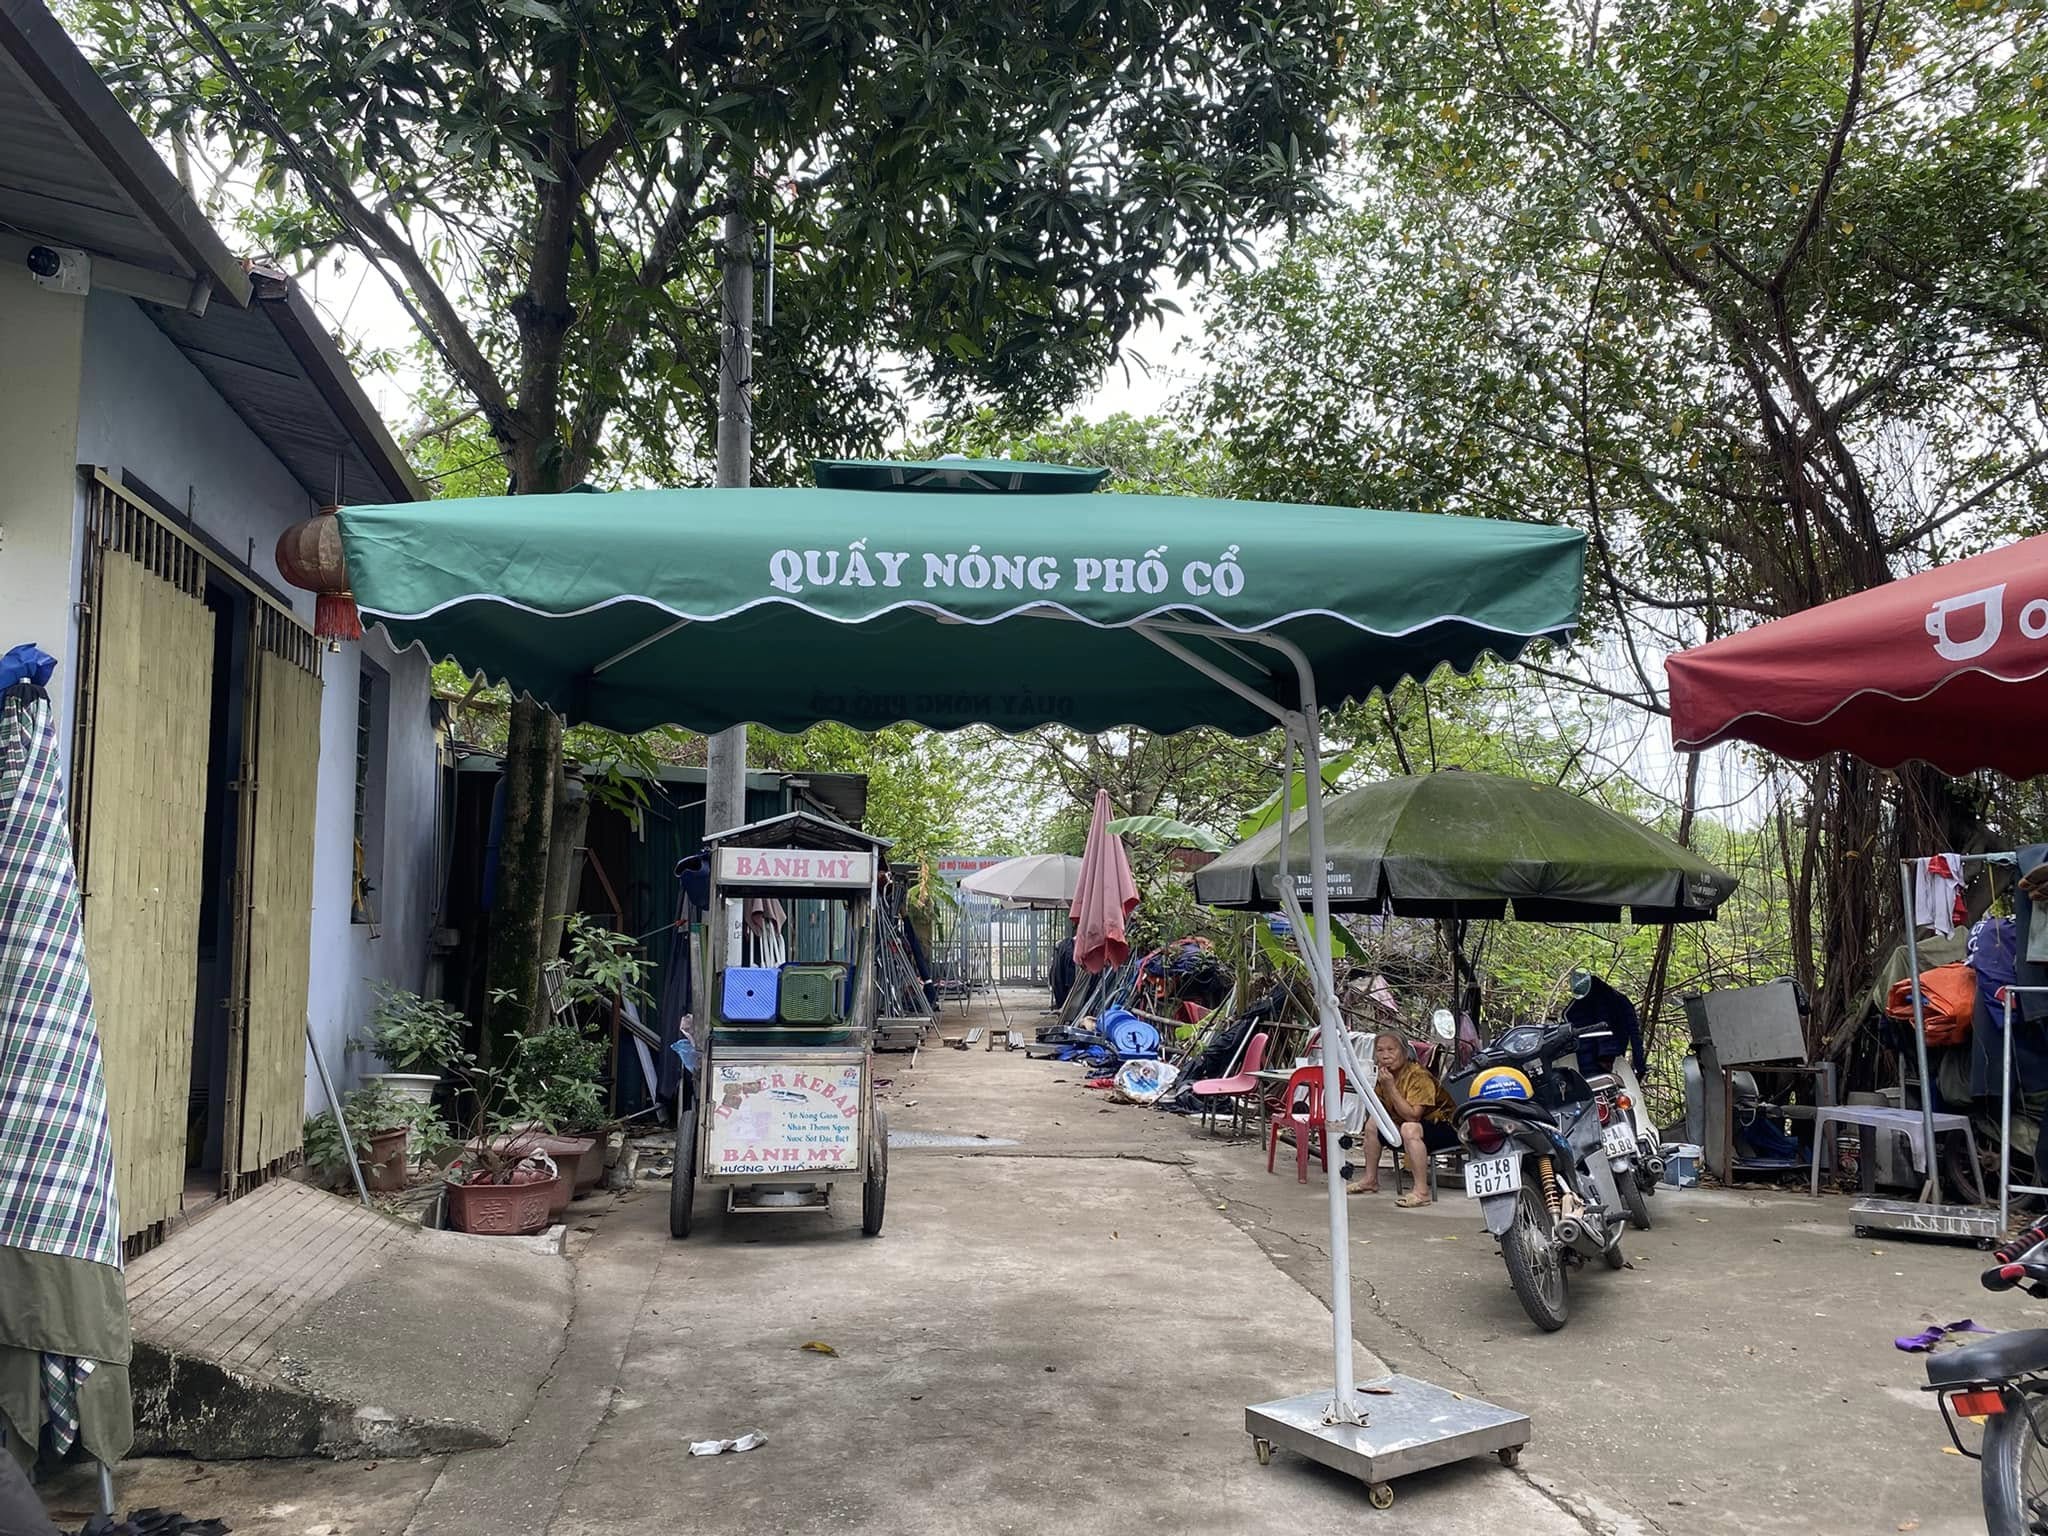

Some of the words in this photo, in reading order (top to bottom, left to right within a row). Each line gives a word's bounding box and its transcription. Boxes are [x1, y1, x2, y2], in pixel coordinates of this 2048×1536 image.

[769, 537, 910, 593] QUẤY
[923, 545, 1061, 590] NÓNG
[1073, 545, 1169, 594] PHỐ
[1182, 545, 1245, 597] CỔ
[736, 852, 810, 878] BÁNH
[793, 1072, 858, 1119] KEBAB
[723, 1145, 799, 1162] BÁNH
[720, 1164, 764, 1173] HƯƠNG
[1473, 1159, 1511, 1178] 30-K8
[1475, 1174, 1512, 1194] 6071
